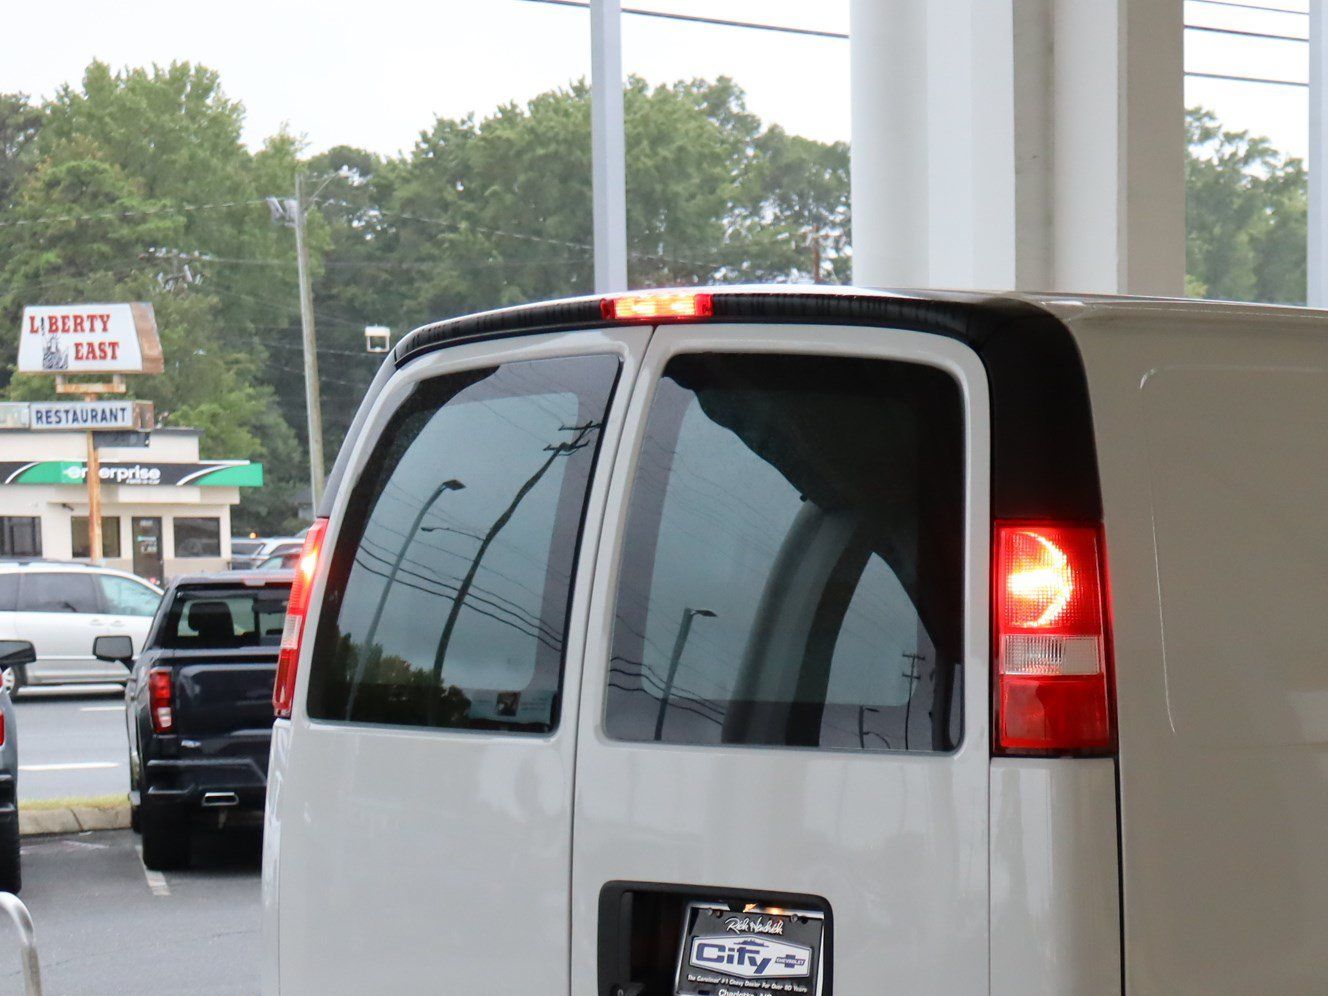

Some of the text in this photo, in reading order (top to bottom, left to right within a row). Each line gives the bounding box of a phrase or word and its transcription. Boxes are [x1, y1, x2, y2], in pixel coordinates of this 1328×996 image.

[28, 314, 111, 336] LIBERTY
[74, 341, 119, 360] EAST
[35, 407, 128, 425] RESTAURANT
[730, 979, 744, 988] Chevy
[745, 980, 760, 988] Dealer
[793, 985, 807, 993] Years
